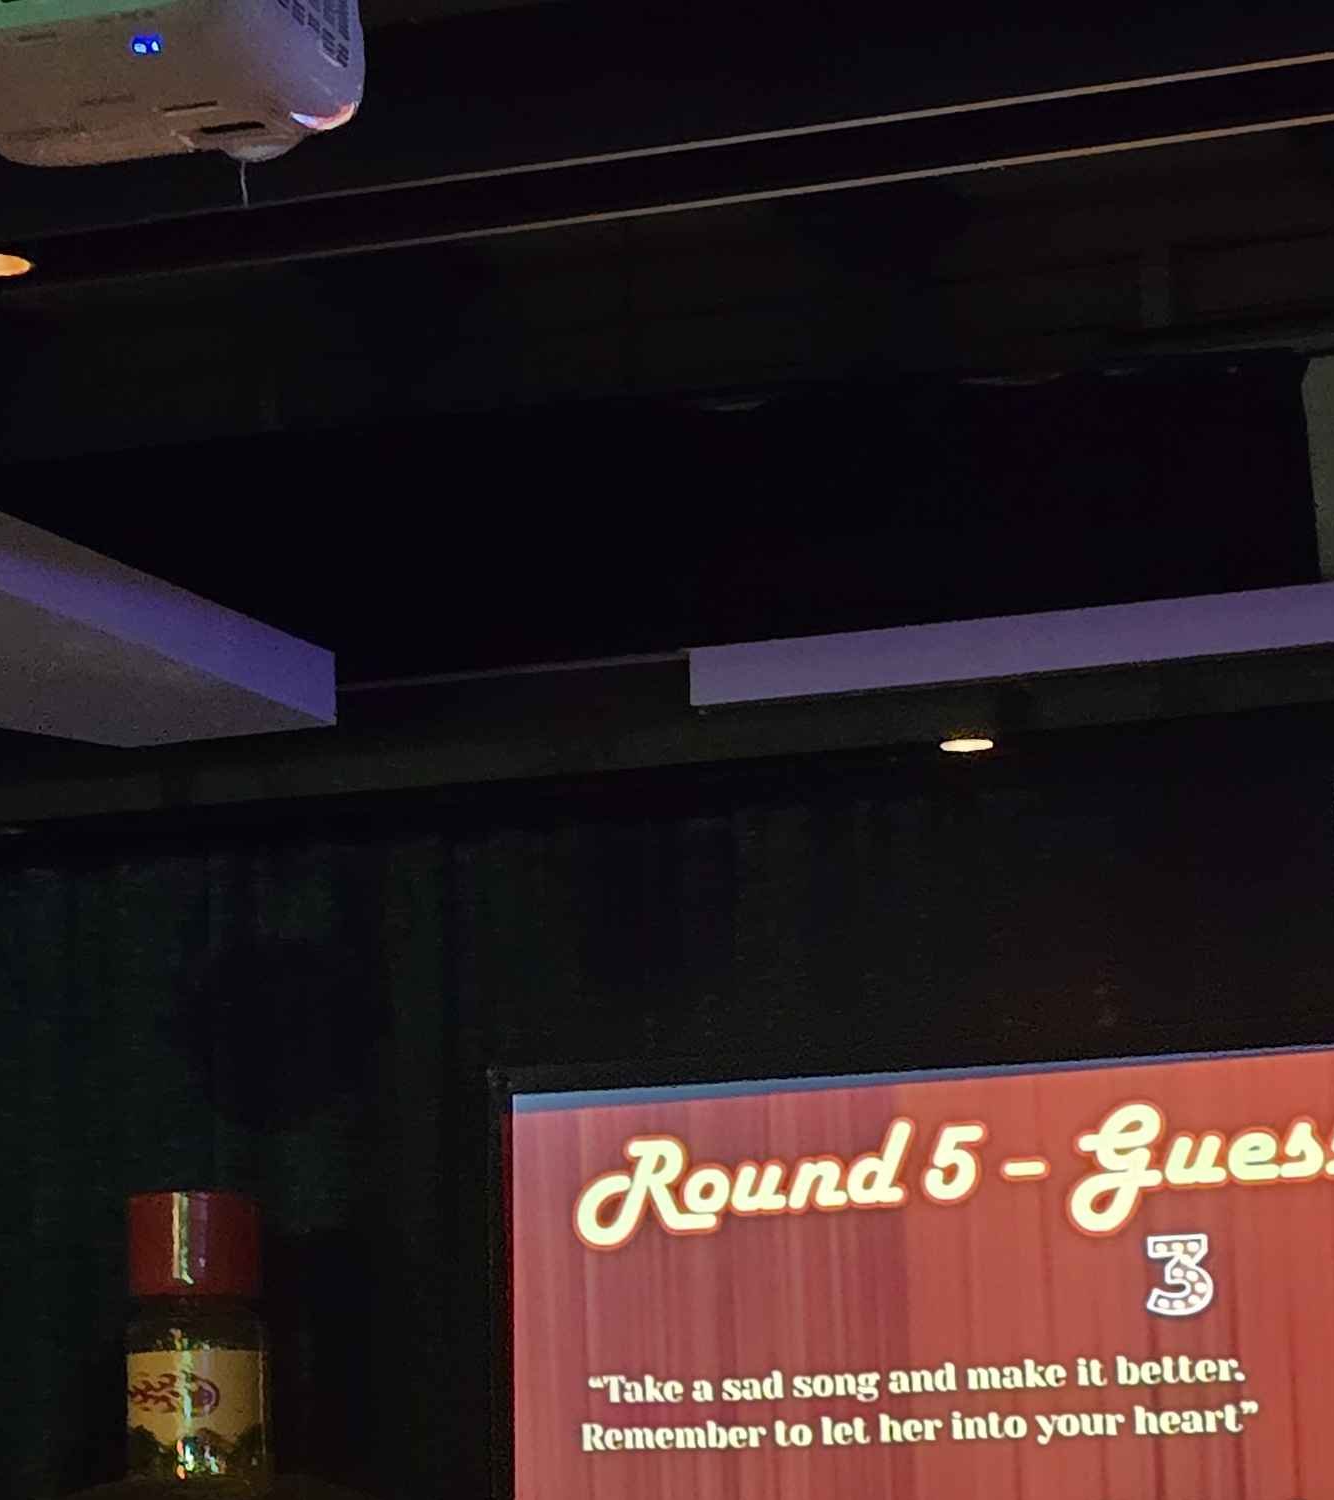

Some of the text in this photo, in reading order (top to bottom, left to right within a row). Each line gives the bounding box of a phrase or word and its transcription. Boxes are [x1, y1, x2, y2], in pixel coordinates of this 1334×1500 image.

[576, 1120, 912, 1246] Round
[924, 1125, 984, 1200] 5
[1146, 1233, 1214, 1316] 3
[588, 1355, 1246, 1403] “Take a sad song and make it better.
[582, 1400, 1259, 1452] Remember to let her into your heart”
